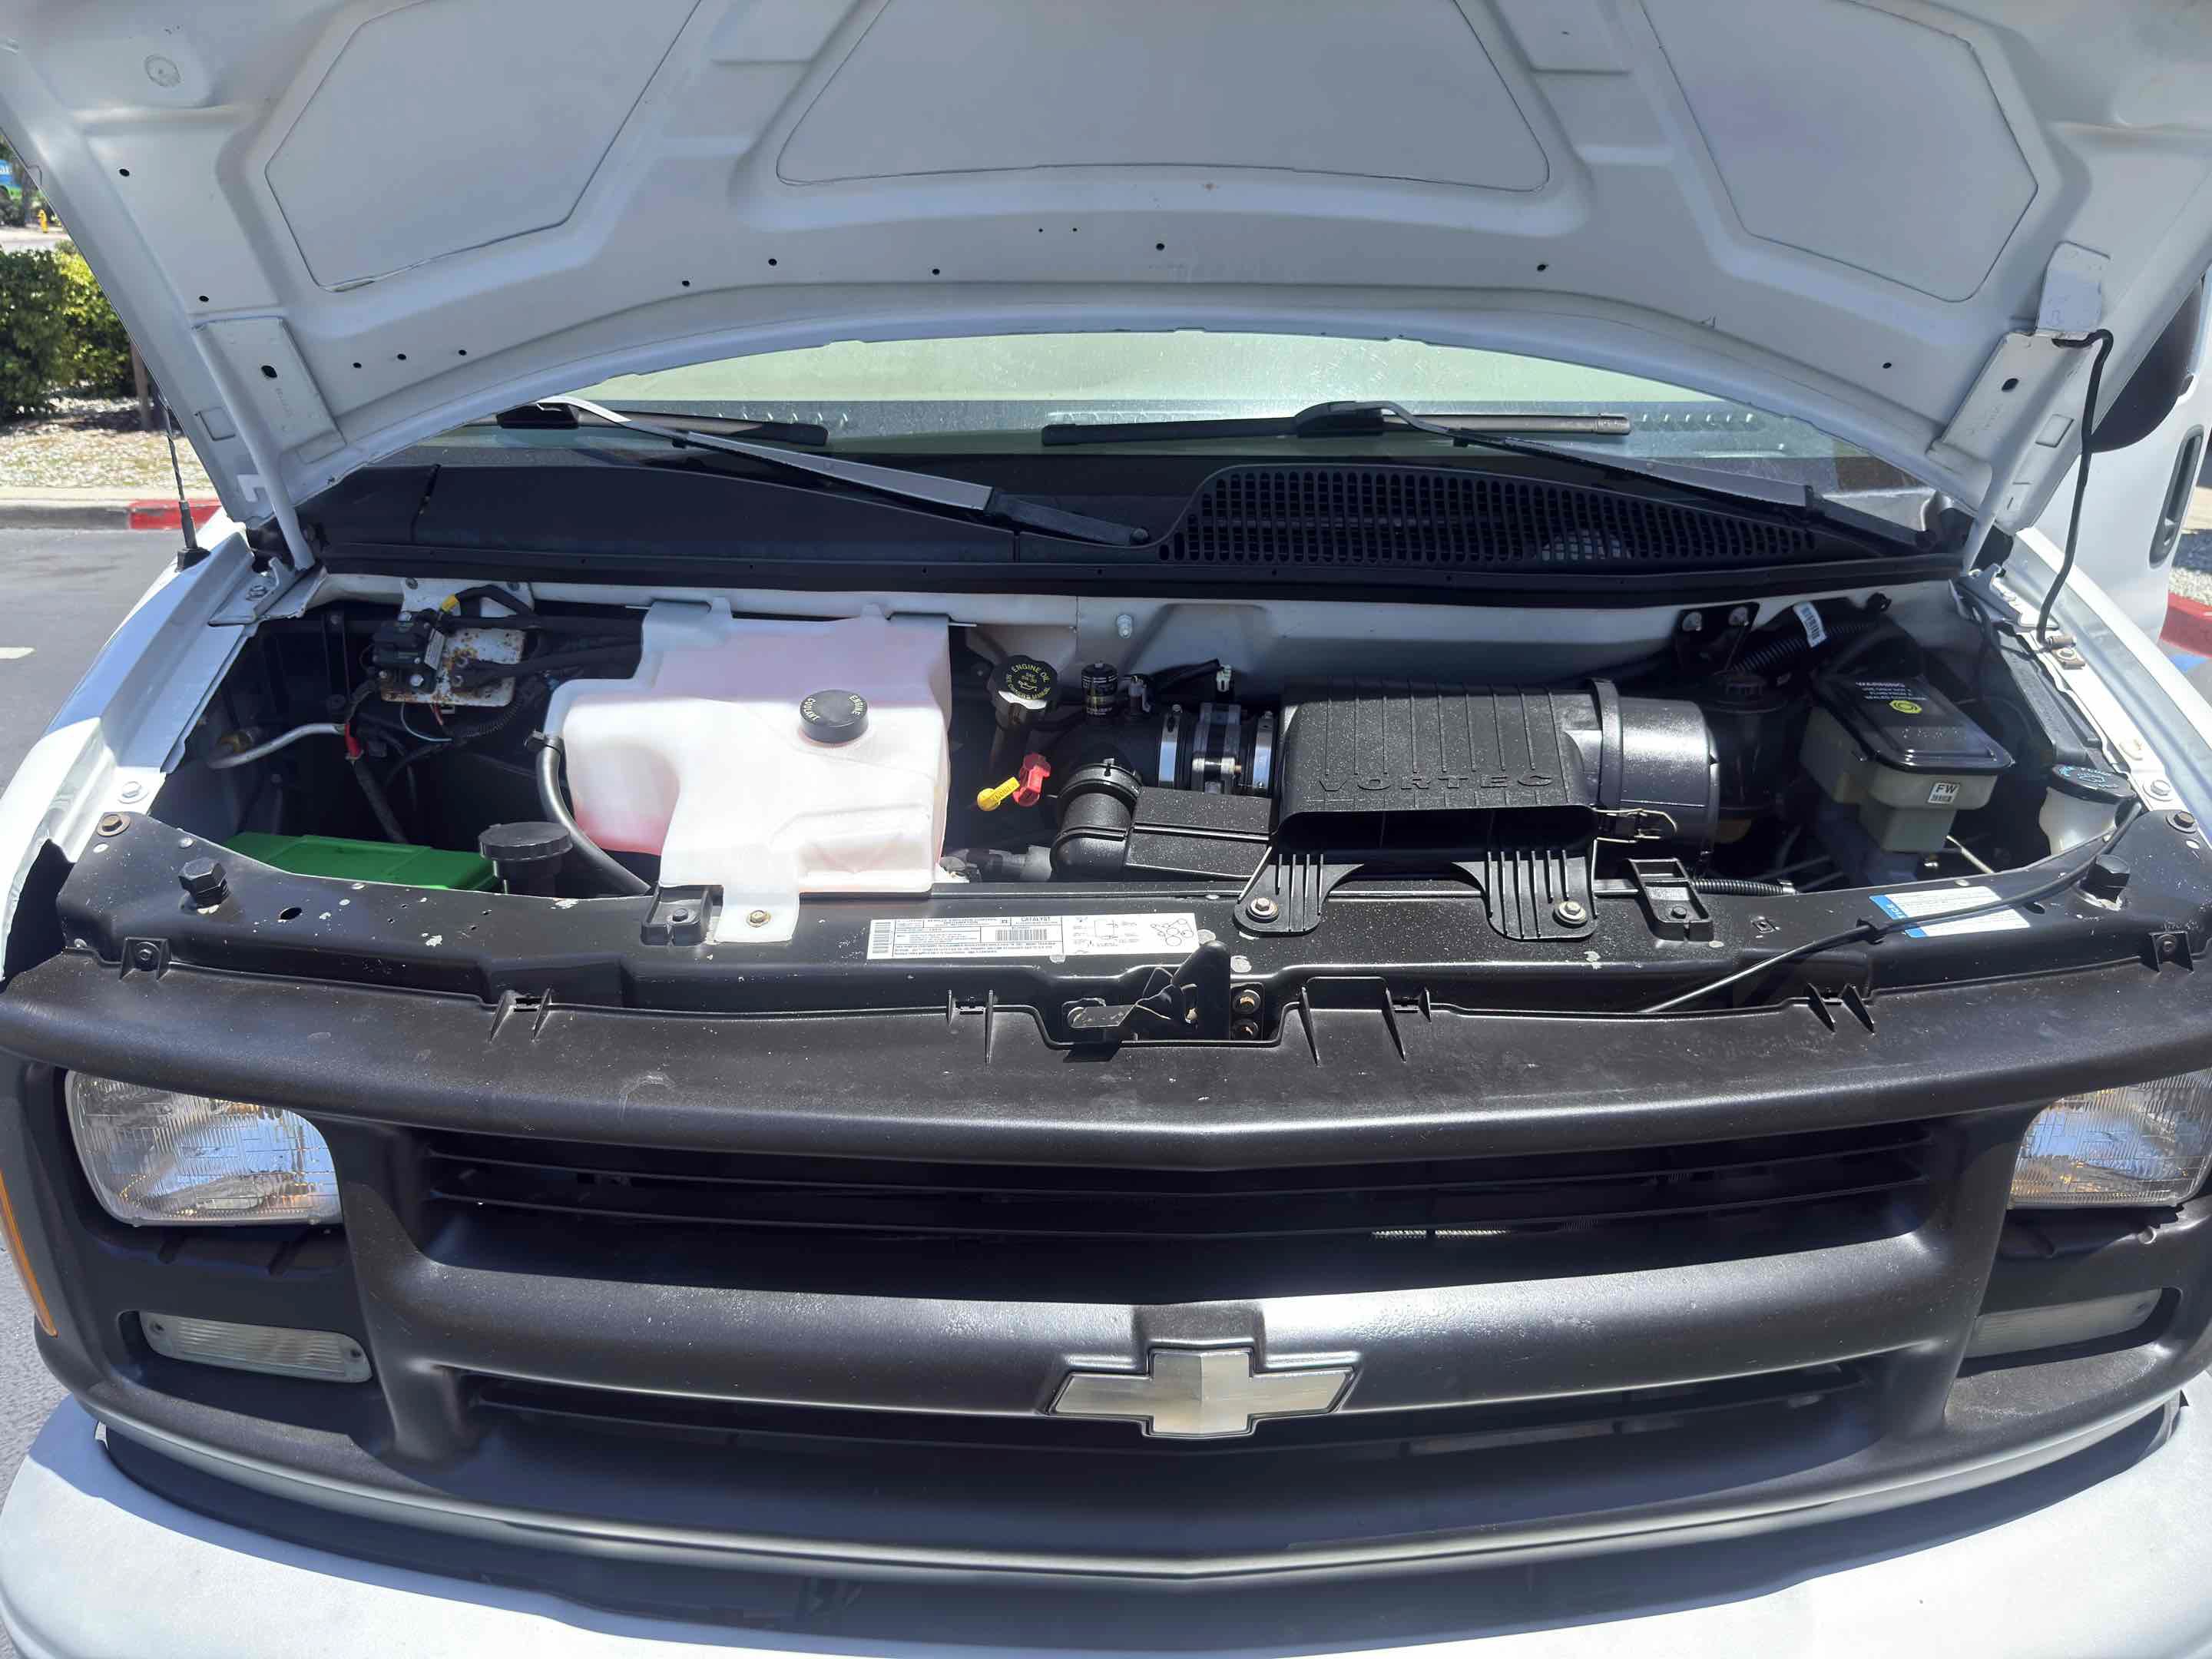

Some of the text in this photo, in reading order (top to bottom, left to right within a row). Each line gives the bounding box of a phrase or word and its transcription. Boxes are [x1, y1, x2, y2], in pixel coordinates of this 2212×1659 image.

[1011, 663, 1041, 674] ENGINE
[803, 694, 864, 721] ENGINE COOLANT
[1318, 774, 1554, 792] VORTEC
[1935, 783, 1956, 793] FW
